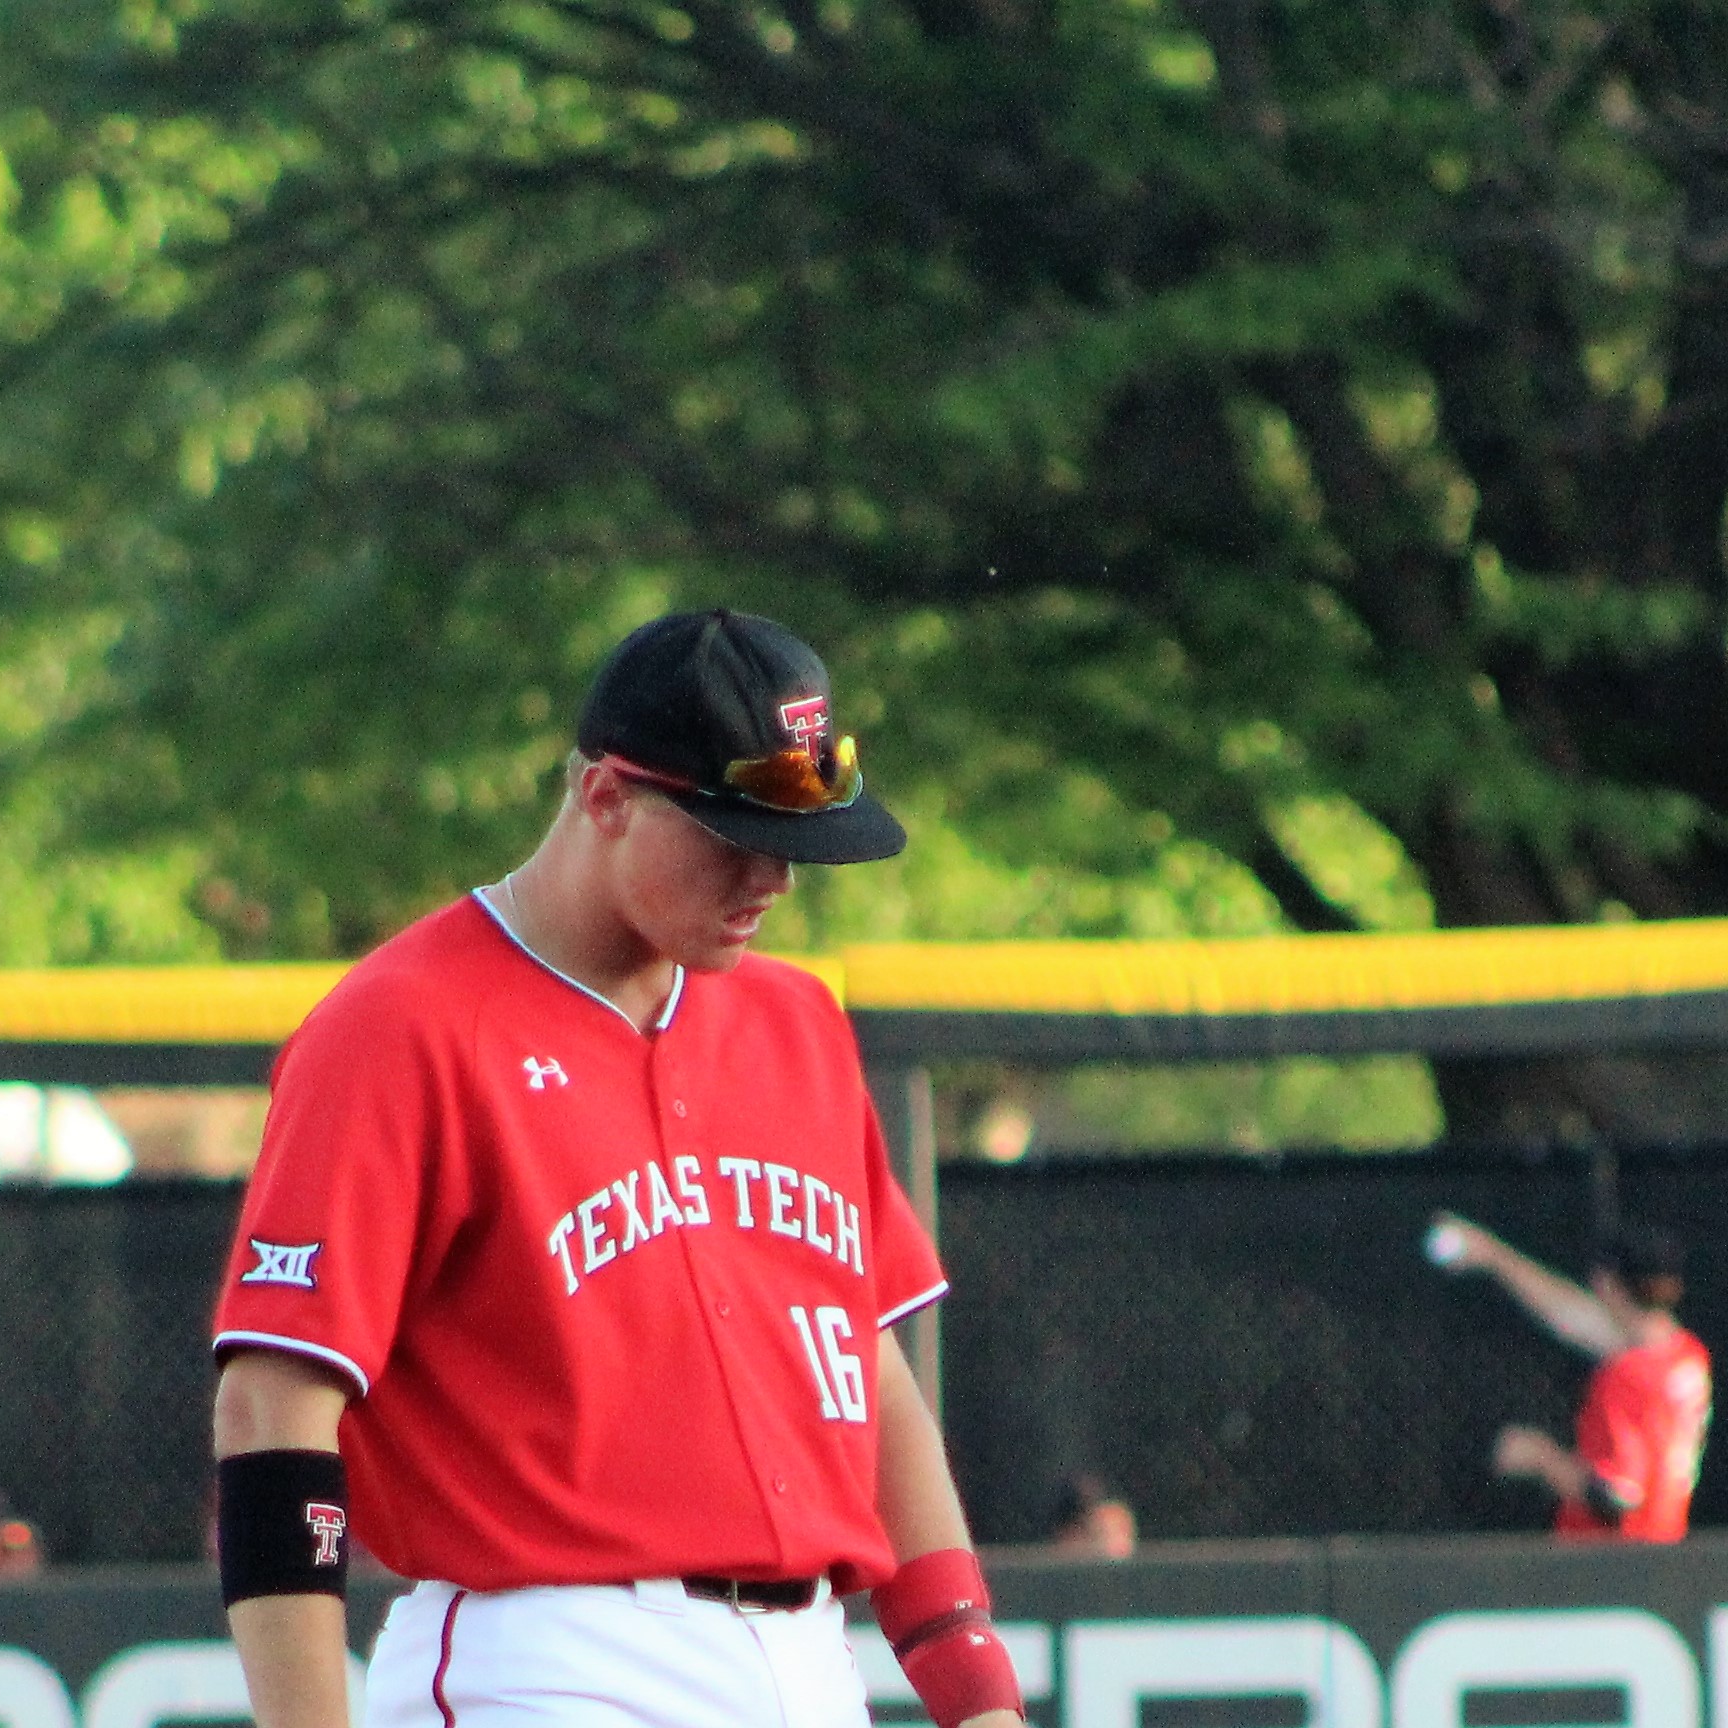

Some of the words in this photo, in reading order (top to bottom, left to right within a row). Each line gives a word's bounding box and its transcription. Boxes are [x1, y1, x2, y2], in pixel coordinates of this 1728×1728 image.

[548, 1155, 712, 1296] TEXAS
[718, 1156, 866, 1277] TECH
[789, 1306, 868, 1424] 16
